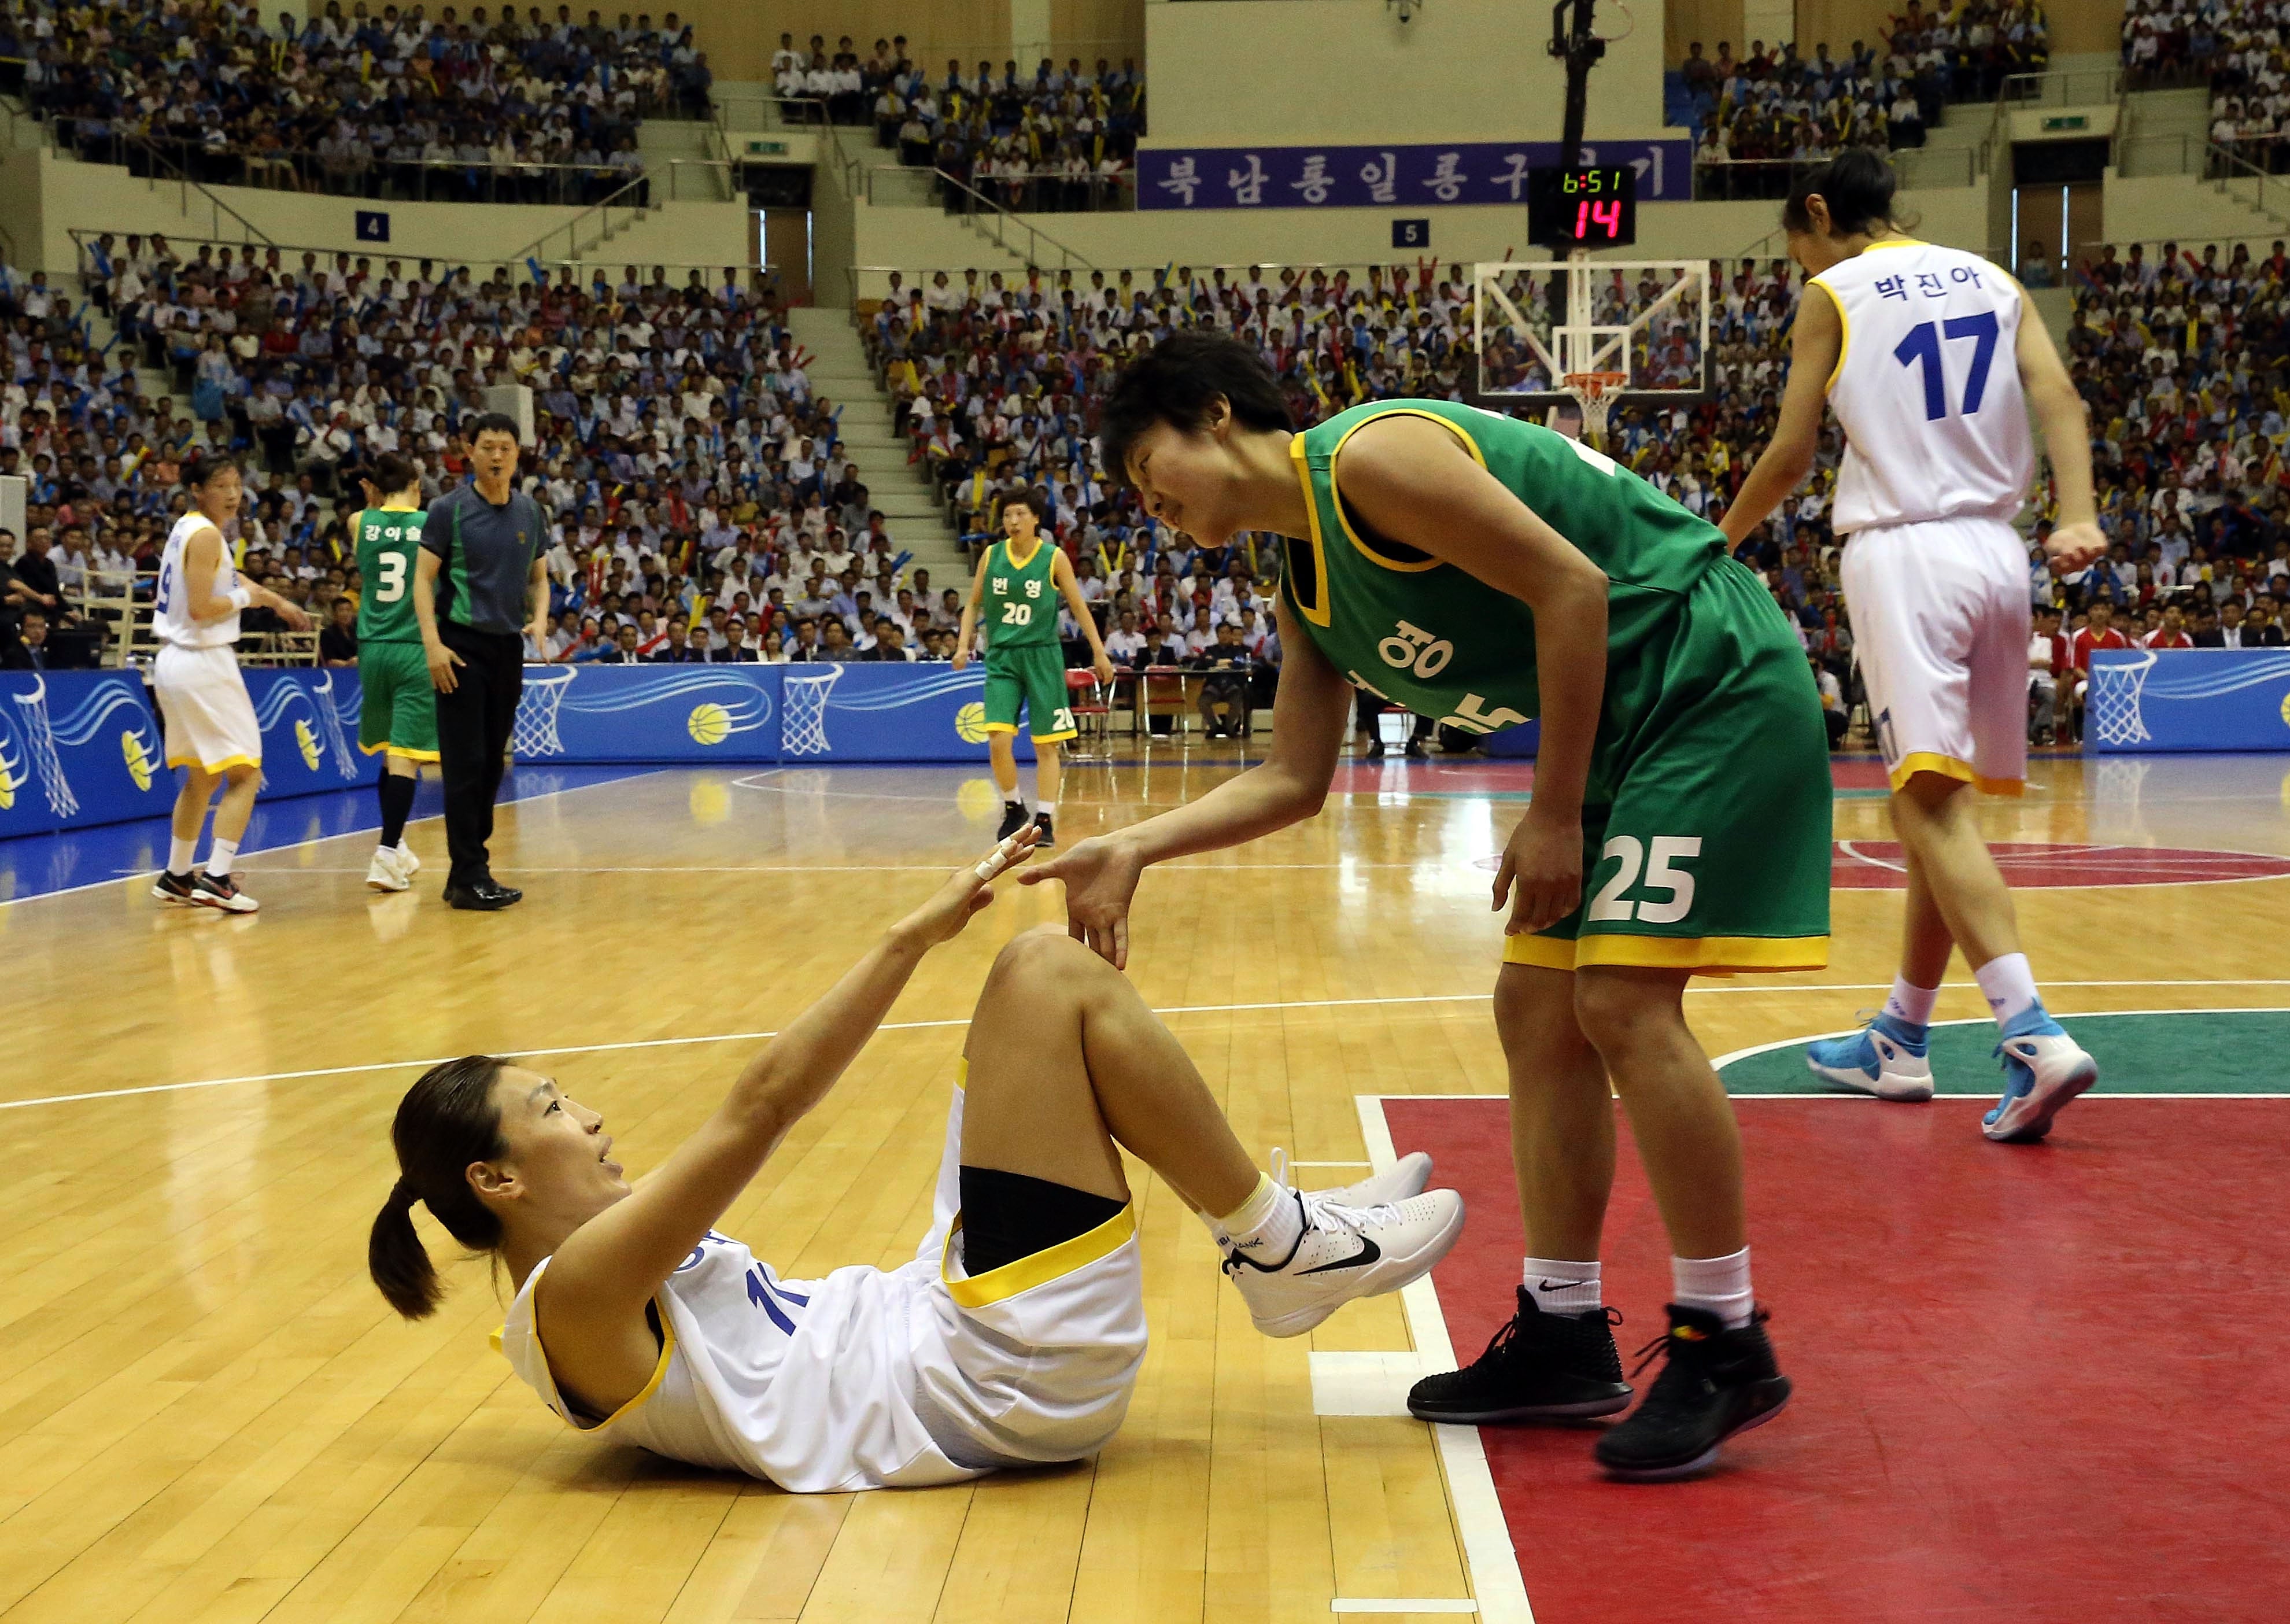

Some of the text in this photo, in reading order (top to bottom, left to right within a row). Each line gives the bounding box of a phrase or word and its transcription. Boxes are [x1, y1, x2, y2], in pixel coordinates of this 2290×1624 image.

[1563, 169, 1620, 194] 6:51
[367, 218, 379, 235] 4
[1405, 224, 1417, 242] 5
[1575, 200, 1621, 239] 14
[1875, 266, 1982, 301] 박진아
[1893, 310, 2000, 422] 17
[376, 551, 407, 603] 3
[1001, 601, 1032, 626] 20
[1052, 707, 1075, 731] 20
[1587, 835, 1702, 924] 25
